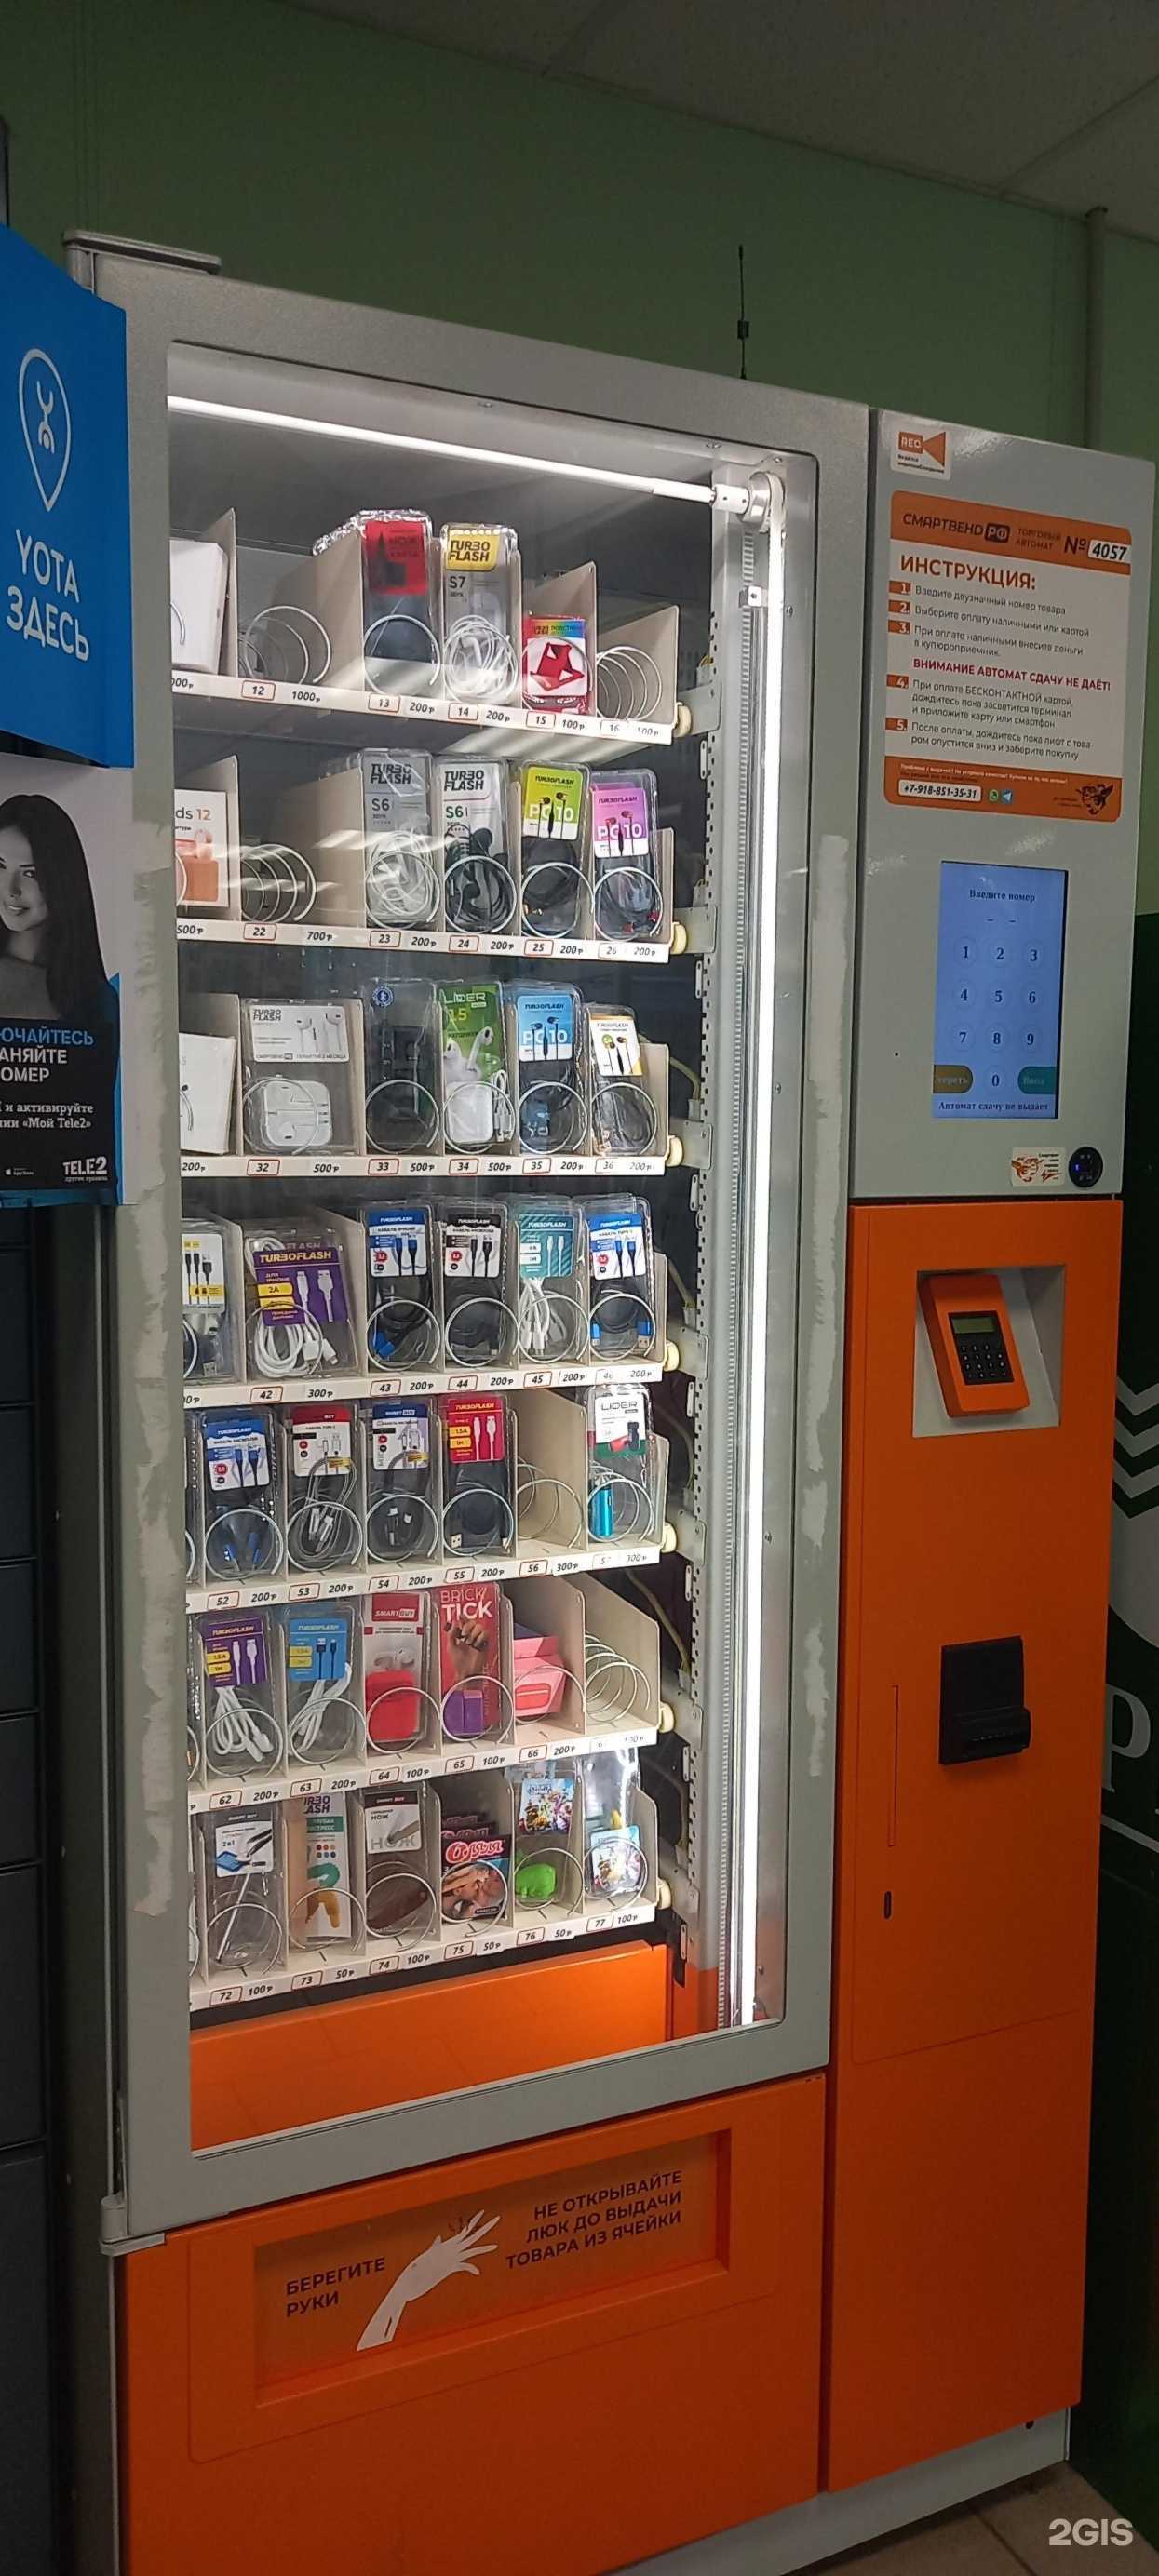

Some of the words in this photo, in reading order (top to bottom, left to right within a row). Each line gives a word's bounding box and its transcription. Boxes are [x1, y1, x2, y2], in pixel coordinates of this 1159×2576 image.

[903, 514, 984, 536] СМАРТВЕНД
[989, 527, 1007, 541] РФ
[1015, 538, 1054, 550] АВТОМАТ
[1064, 536, 1087, 554] №
[1092, 543, 1127, 560] 4057
[449, 551, 490, 562] FLASH
[16, 529, 80, 603] YOTA
[901, 555, 1036, 590] ИНСТРУКЦИЯ:
[449, 576, 466, 588] S7
[900, 583, 910, 595] 1.
[916, 585, 952, 599] Введите
[953, 592, 1005, 607] двузначный
[1008, 599, 1035, 611] номер
[1038, 603, 1066, 615] товара
[7, 585, 90, 663] ЗДЕСЬ
[899, 602, 910, 614] 2.
[915, 605, 959, 621] Выберите
[961, 612, 990, 625] оплату
[992, 617, 1042, 631] наличными
[1044, 623, 1059, 632] или
[1061, 625, 1089, 637] картой
[898, 623, 909, 634] 3.
[914, 625, 933, 637] При
[935, 629, 964, 640] оплате
[966, 633, 1017, 648] наличными
[1018, 640, 1052, 651] внесите
[1054, 644, 1083, 656] деньги
[913, 658, 975, 674] ВНИМАНИЕ
[977, 666, 1027, 680] АВТОМАТ
[1029, 673, 1063, 685] СДАЧУ
[1066, 677, 1079, 687] НЕ
[1081, 678, 1111, 690] ДАЁТ!
[252, 686, 264, 695] 12
[913, 680, 932, 691] При
[934, 683, 964, 694] оплате
[965, 685, 1042, 702] БЕСКОНТАКТНОЙ
[379, 699, 390, 707] 13
[911, 694, 960, 706] дождитесь
[962, 699, 982, 708] пока
[984, 701, 1029, 714] засветится
[1031, 706, 1071, 718] терминал
[458, 707, 469, 716] 14
[535, 716, 546, 725] 15
[920, 708, 969, 720] приложите
[971, 713, 994, 723] карту
[996, 715, 1012, 723] или
[1015, 718, 1056, 729] смартфон
[896, 719, 908, 731] 5.
[911, 722, 938, 733] После
[976, 731, 1021, 743] дождитесь
[1023, 734, 1043, 745] пока
[1044, 735, 1065, 746] лифт
[1072, 739, 1094, 749] това-
[911, 736, 929, 746] ром
[931, 737, 974, 750] опустится
[976, 744, 996, 752] вниз
[1005, 745, 1044, 757] заберите
[1045, 748, 1079, 760] покупку
[444, 781, 484, 791] FLASH
[904, 784, 977, 798] +7-918-851-35-31
[372, 798, 390, 811] S6
[196, 808, 211, 821] 12
[446, 806, 464, 818] S6
[969, 889, 1006, 900] Введите
[1008, 892, 1035, 903] номер
[253, 927, 266, 936] 22
[379, 934, 391, 944] 23
[458, 938, 469, 948] 24
[532, 942, 544, 952] 25
[963, 946, 968, 959] 1
[996, 947, 1004, 960] 2
[1031, 950, 1038, 961] 3
[961, 989, 968, 1001] 4
[995, 990, 1003, 1002] 5
[1029, 991, 1036, 1003] 6
[960, 1032, 966, 1043] 7
[993, 1032, 1001, 1045] 8
[1027, 1034, 1033, 1045] 9
[991, 1075, 999, 1086] 0
[17, 1103, 93, 1118] активируйте
[938, 1101, 976, 1110] Автомат
[978, 1102, 1003, 1112] сдачу
[63, 1156, 107, 1174] TELE2
[256, 1163, 269, 1172] 32
[377, 1162, 389, 1171] 33
[457, 1161, 469, 1171] 34
[532, 1161, 542, 1171] 35
[259, 1251, 331, 1263] TURBOFLASH
[456, 1378, 468, 1389] 44
[532, 1375, 543, 1385] 45
[379, 1383, 392, 1392] 43
[259, 1390, 273, 1400] 42
[528, 1563, 539, 1573] 56
[454, 1570, 465, 1580] 55
[377, 1579, 390, 1589] 54
[298, 1588, 310, 1596] 53
[440, 1587, 487, 1603] BRICK
[216, 1596, 230, 1606] 52
[441, 1601, 492, 1624] TICK
[528, 1749, 539, 1758] 66
[453, 1760, 465, 1770] 65
[378, 1771, 390, 1780] 64
[299, 1783, 312, 1792] 63
[219, 1795, 232, 1805] 62
[595, 1918, 606, 1927] 77
[525, 1931, 536, 1940] 76
[452, 1945, 465, 1955] 75
[379, 1961, 390, 1970] 74
[301, 1976, 313, 1985] 73
[219, 1992, 232, 2001] 72
[533, 2203, 558, 2221] НЕ
[562, 2169, 682, 2214] ОТКРЫВАЙТЕ
[526, 2220, 570, 2245] ЛЮК
[574, 2213, 601, 2236] ДО
[606, 2190, 682, 2224] ВЫДАЧИ
[505, 2238, 580, 2270] ТОВАРА
[585, 2230, 608, 2248] ИЗ
[613, 2210, 682, 2241] ЯЧЕЙКИ
[286, 2256, 386, 2296] БЕРЕГИТЕ
[286, 2291, 340, 2317] РУКИ
